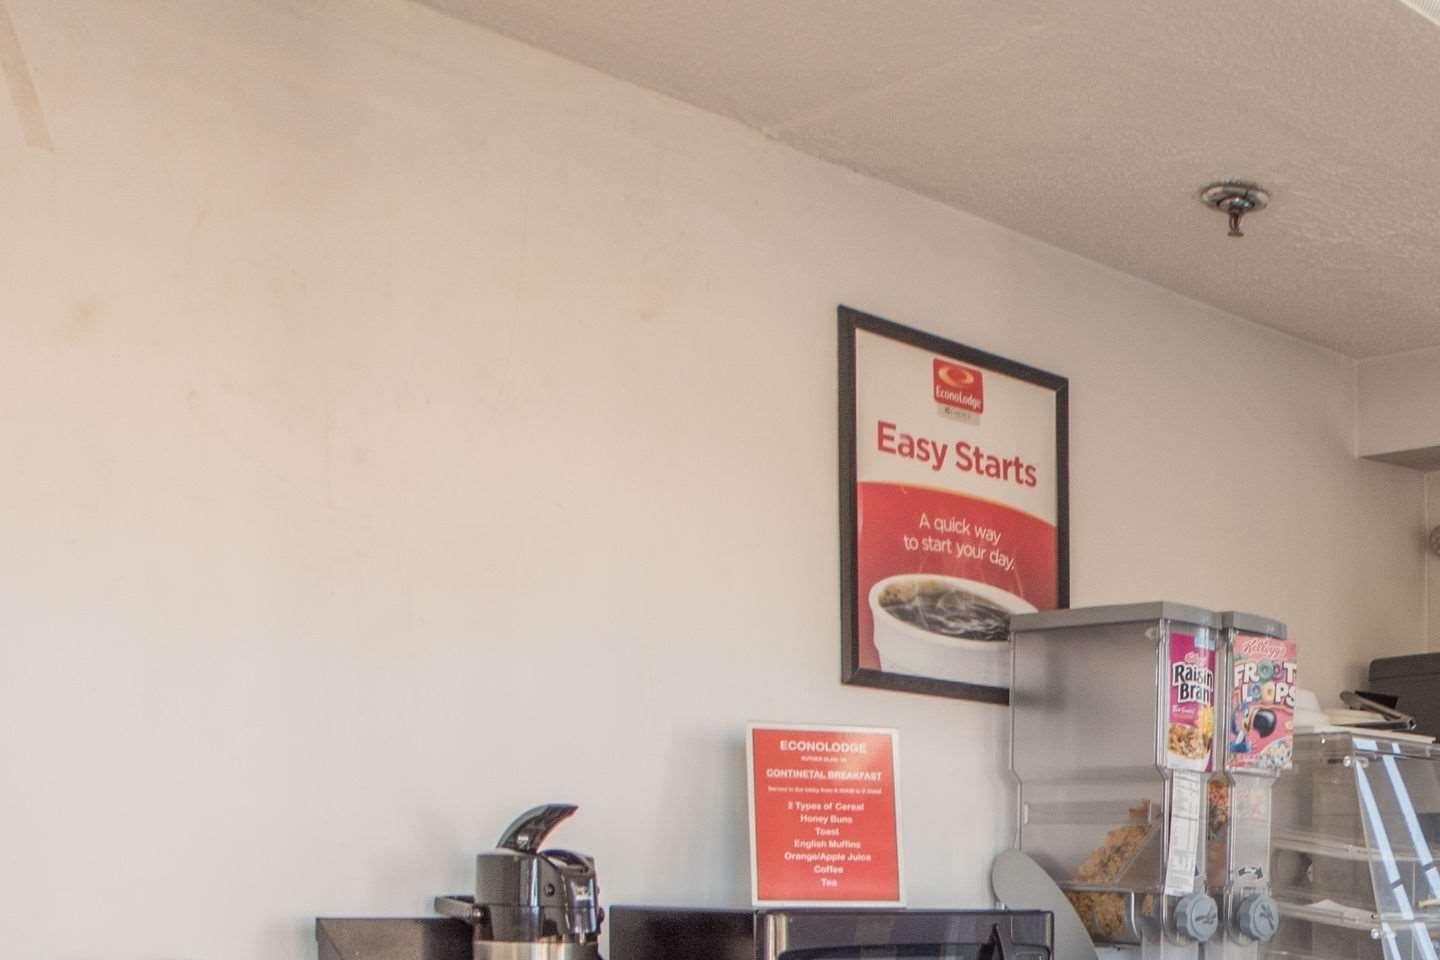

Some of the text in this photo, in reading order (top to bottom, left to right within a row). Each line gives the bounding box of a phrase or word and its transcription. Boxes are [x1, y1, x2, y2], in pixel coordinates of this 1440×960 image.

[877, 420, 1037, 487] Easy Starts
[919, 512, 1001, 546] A quick way
[903, 534, 919, 551] to
[921, 535, 952, 554] start
[956, 541, 987, 560] your
[1173, 663, 1214, 688] Raisin
[1234, 661, 1296, 690] FROOT
[1178, 682, 1210, 702] Bran
[1242, 681, 1296, 709] LOOPS
[779, 740, 867, 754] ECONOLODGE
[787, 801, 865, 812] 2 Types of Cereal
[800, 814, 853, 824] Honey Buns
[815, 827, 840, 836] Toast
[794, 839, 862, 849] English Muffins
[847, 852, 872, 862] Juice
[814, 865, 844, 874] Coffee
[820, 878, 838, 887] Tea
